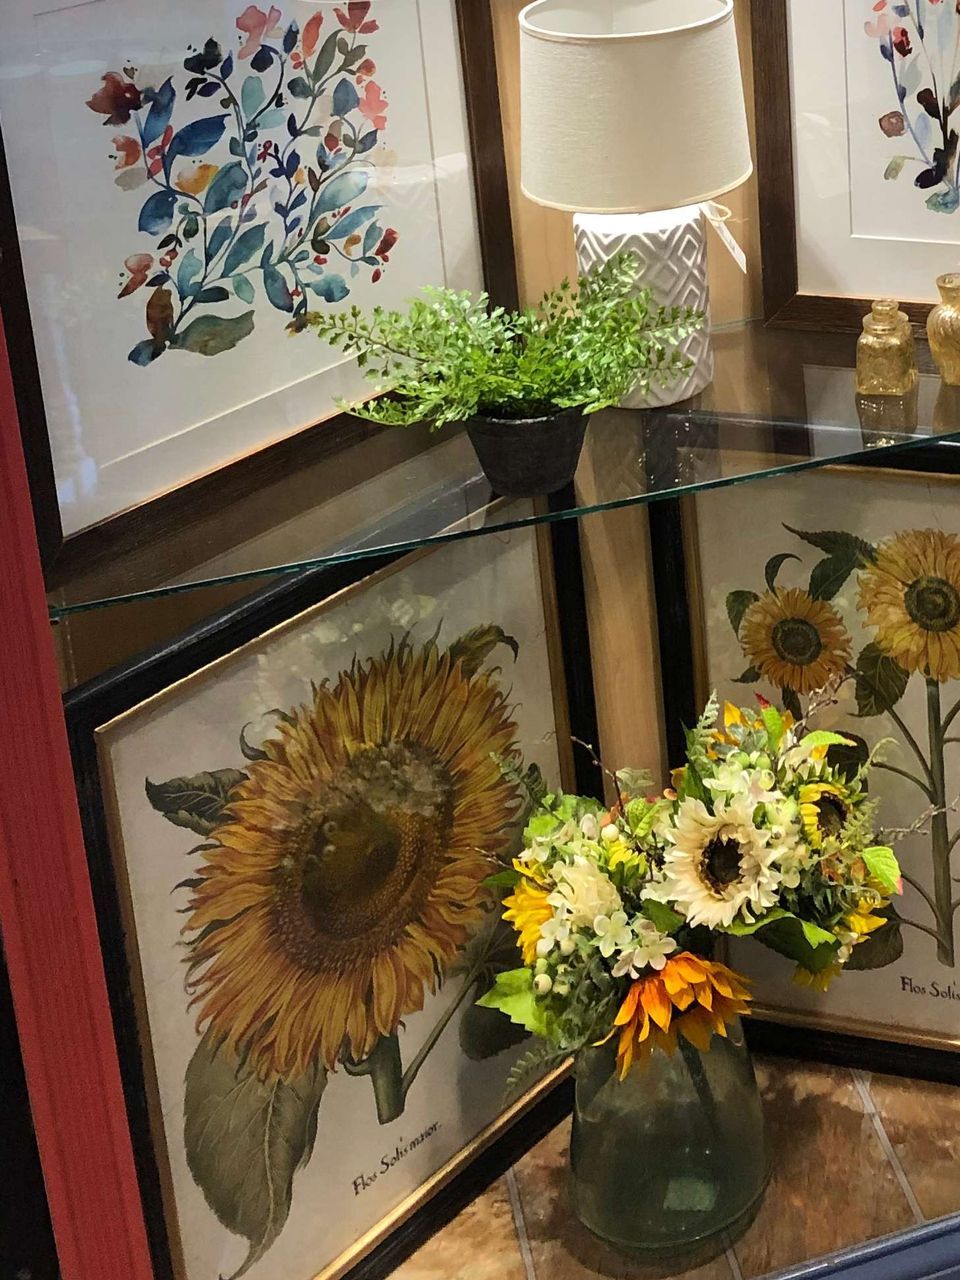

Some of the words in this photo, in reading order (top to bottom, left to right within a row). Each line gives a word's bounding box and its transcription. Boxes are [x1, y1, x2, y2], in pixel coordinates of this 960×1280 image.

[900, 976, 926, 994] Flos
[929, 980, 960, 1000] Solis
[352, 1174, 377, 1196] Flos
